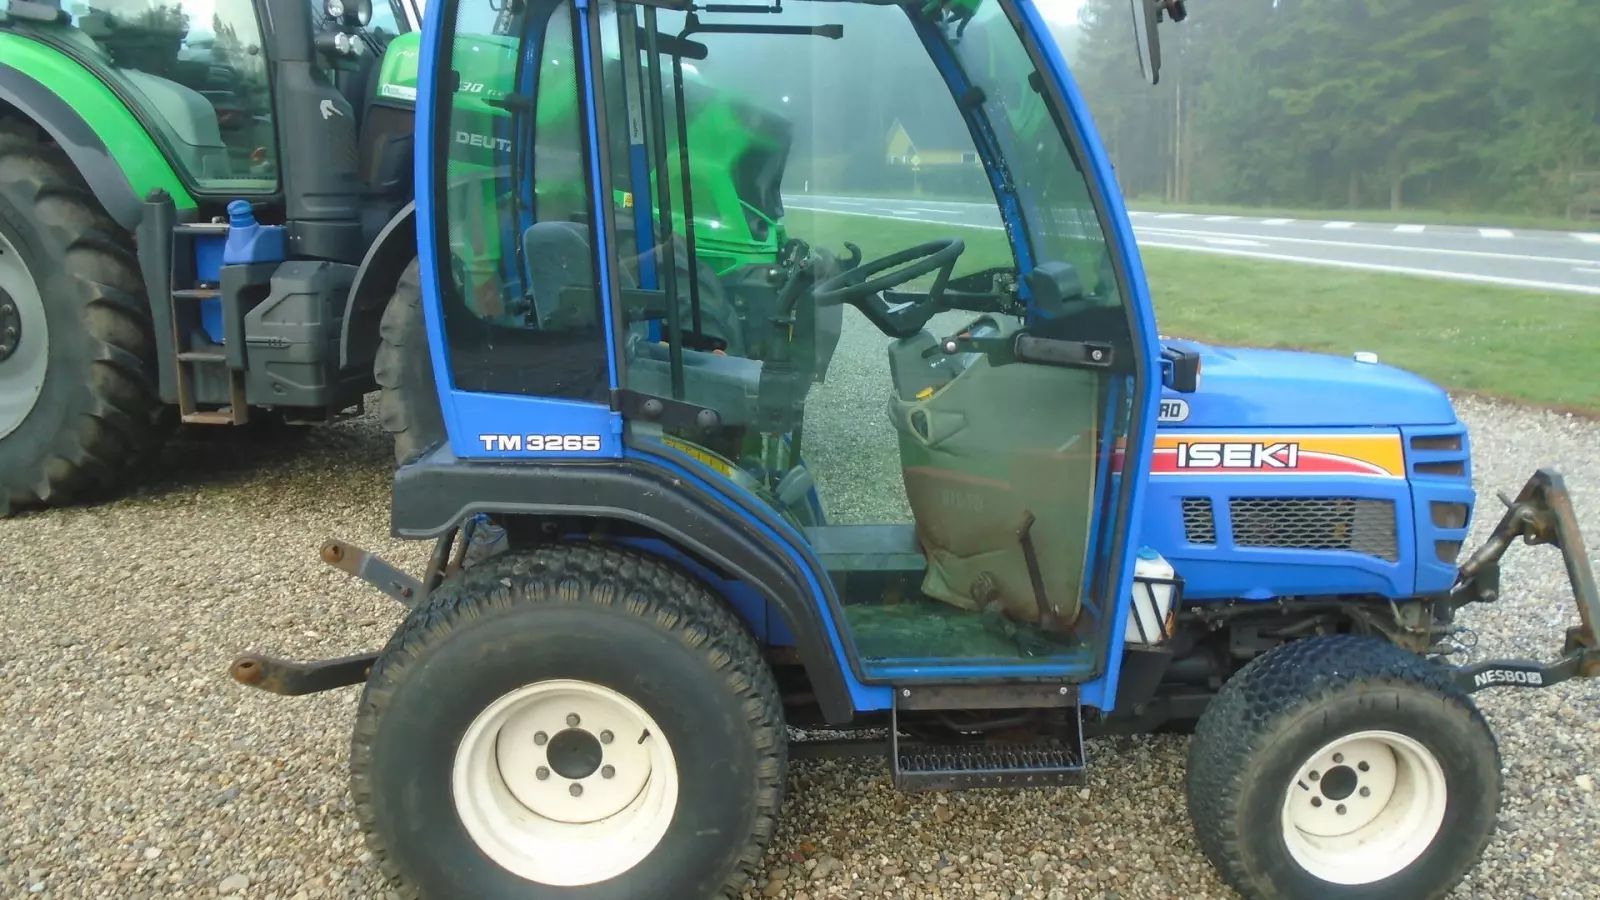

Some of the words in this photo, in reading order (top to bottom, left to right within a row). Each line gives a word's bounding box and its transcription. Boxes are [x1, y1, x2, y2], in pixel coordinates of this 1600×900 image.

[479, 434, 521, 451] TM
[526, 434, 601, 451] 3265
[1176, 442, 1299, 469] ISEKI
[1474, 669, 1527, 687] NESBO
